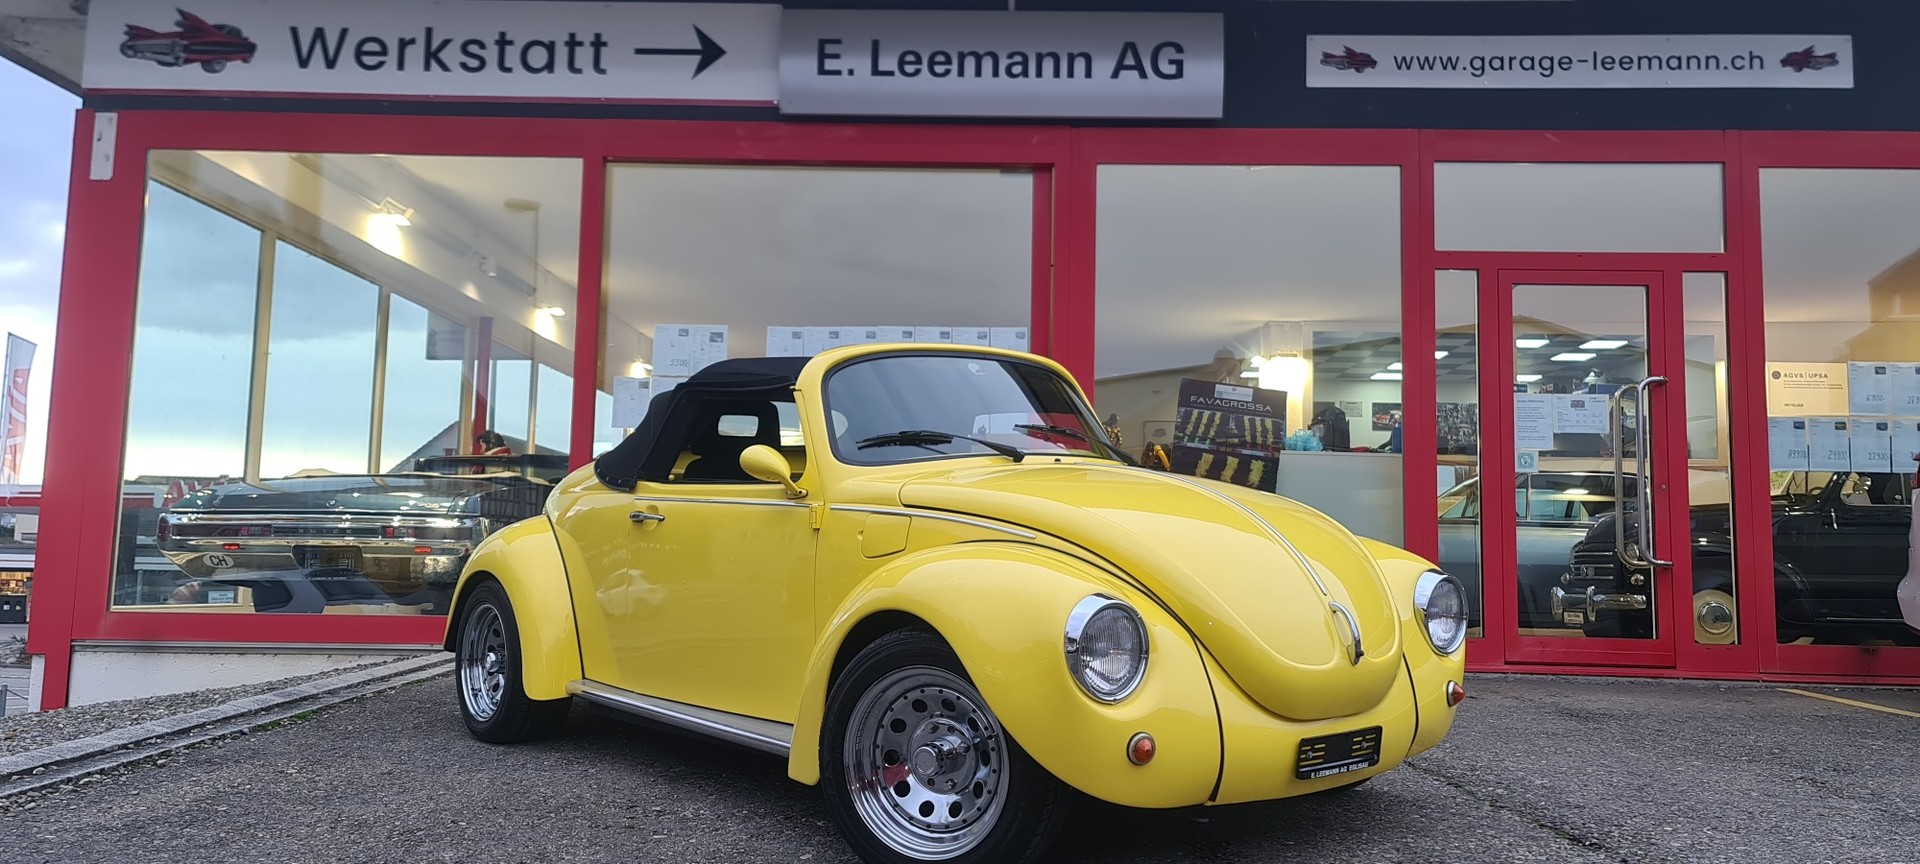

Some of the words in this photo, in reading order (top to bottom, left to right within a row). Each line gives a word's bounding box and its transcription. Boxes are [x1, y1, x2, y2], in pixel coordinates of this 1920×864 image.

[289, 26, 608, 75] Werkstatt
[816, 38, 855, 77] E.
[871, 39, 1093, 80] Leemann
[1109, 41, 1186, 81] AG
[1393, 50, 1766, 78] www.garage-leemann.ch
[1190, 395, 1272, 413] FAVAGROSSA
[209, 555, 229, 567] CH
[1316, 768, 1339, 777] LEEMANN
